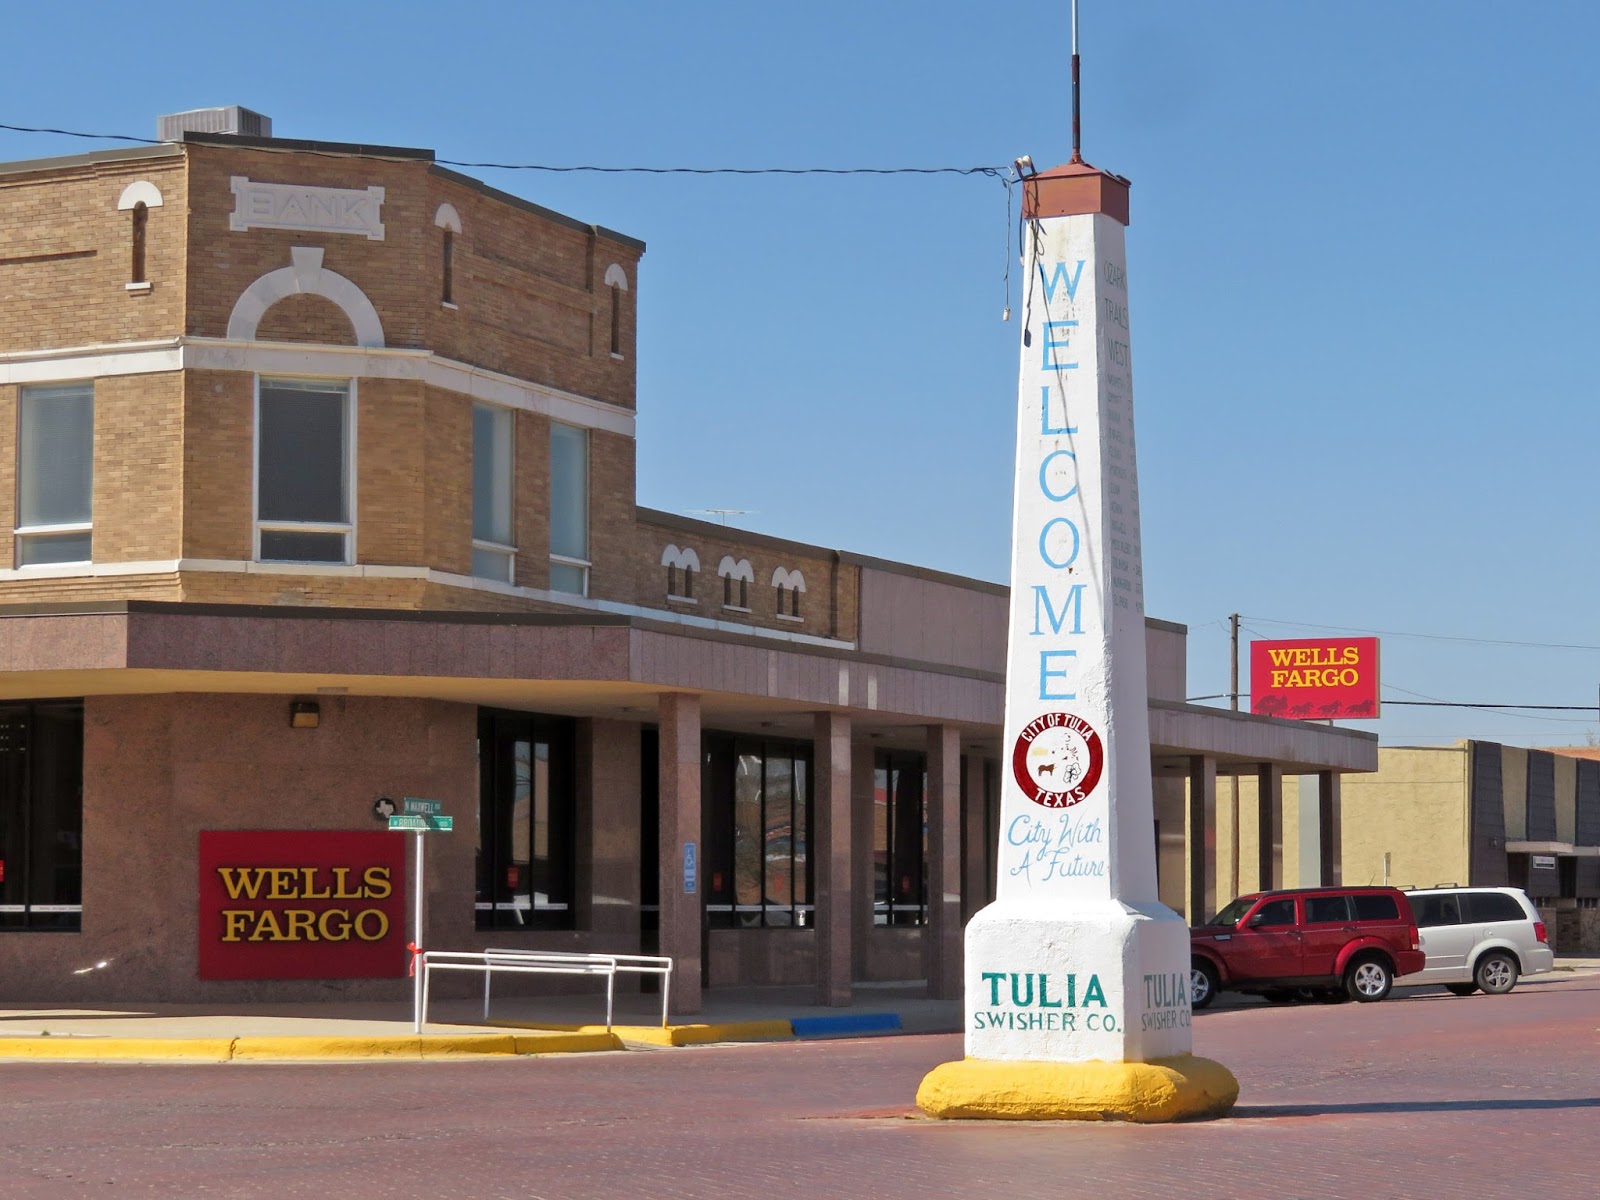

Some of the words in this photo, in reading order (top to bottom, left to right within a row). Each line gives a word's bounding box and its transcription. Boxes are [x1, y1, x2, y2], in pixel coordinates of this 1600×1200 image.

[247, 189, 368, 226] BANK
[1103, 260, 1126, 292] OZARK
[1107, 338, 1129, 367] WEST
[1029, 260, 1088, 700] WELCOME
[1268, 646, 1360, 667] WELLS
[1270, 668, 1359, 688] FARGO
[1021, 717, 1049, 743] CITY
[1047, 713, 1062, 728] OF
[1063, 713, 1095, 742] TULIA
[1034, 786, 1086, 808] TEXAS
[1007, 814, 1052, 861] City
[1058, 809, 1102, 848] With
[217, 866, 393, 899] WELLS
[1010, 849, 1033, 889] A
[1042, 847, 1105, 881] Future
[221, 908, 390, 942] FARGO
[981, 972, 1108, 1008] TULIA
[1143, 972, 1187, 1009] TULIA
[974, 1011, 1077, 1032] SWISHER
[1087, 1013, 1122, 1033] CO.
[1141, 1009, 1178, 1032] SWISHER
